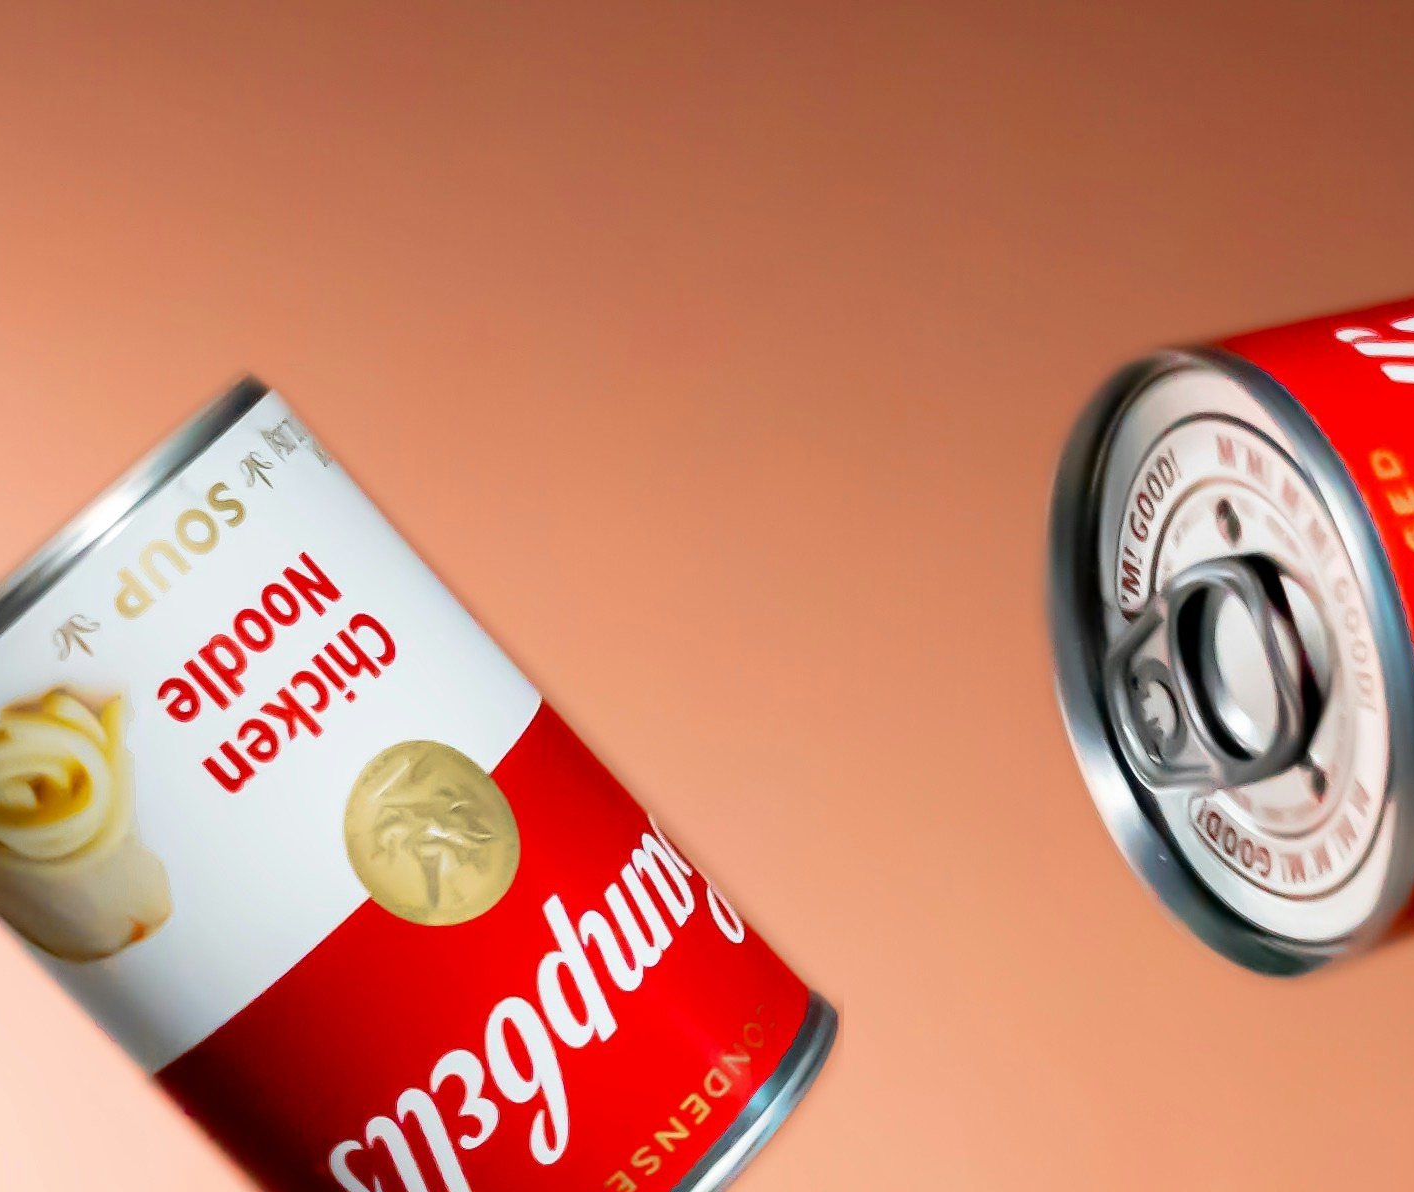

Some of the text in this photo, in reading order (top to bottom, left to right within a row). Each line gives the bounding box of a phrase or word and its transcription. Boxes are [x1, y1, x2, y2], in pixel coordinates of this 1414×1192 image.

[112, 480, 249, 622] SOUP
[1129, 448, 1182, 544] GOOD!
[156, 551, 342, 723] Noodle
[202, 612, 397, 794] Chicken
